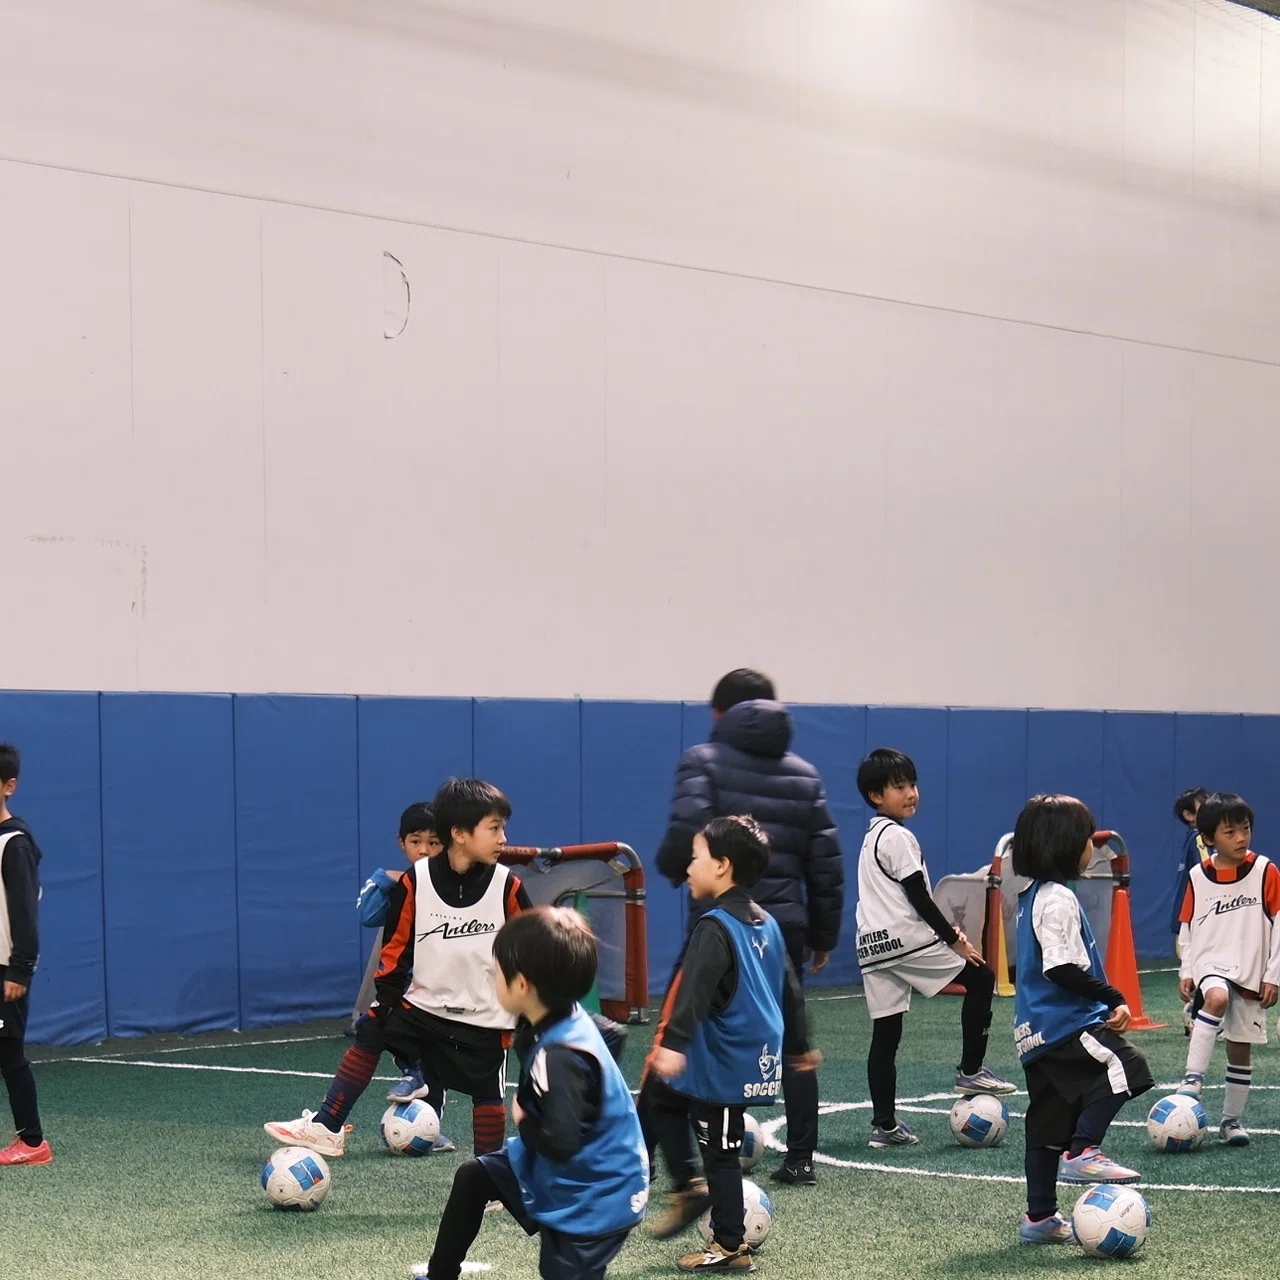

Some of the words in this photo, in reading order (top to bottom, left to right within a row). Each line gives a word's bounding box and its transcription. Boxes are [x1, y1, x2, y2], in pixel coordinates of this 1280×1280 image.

[1196, 894, 1262, 926] Antlers
[416, 919, 499, 943] Antlers
[859, 929, 889, 946] ANTLERS
[869, 937, 904, 955] SCHOOL
[744, 1080, 782, 1098] SOCCE
